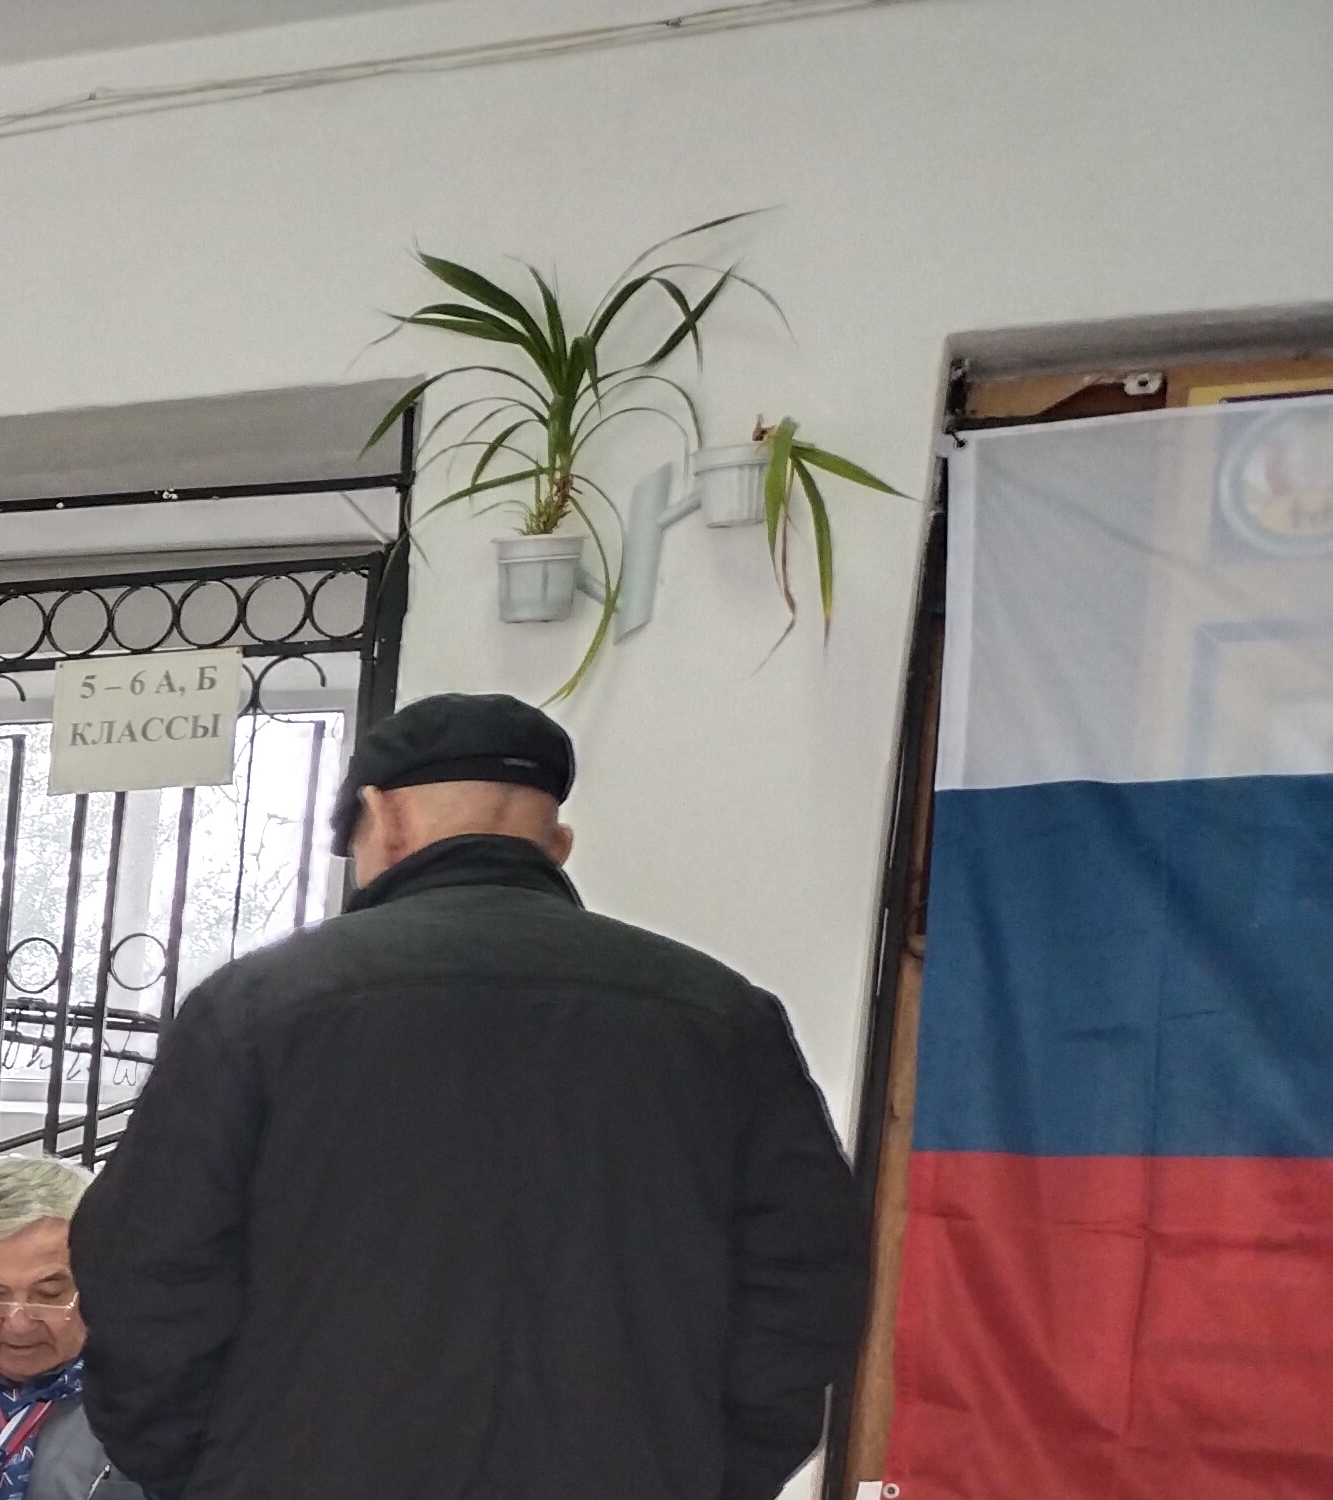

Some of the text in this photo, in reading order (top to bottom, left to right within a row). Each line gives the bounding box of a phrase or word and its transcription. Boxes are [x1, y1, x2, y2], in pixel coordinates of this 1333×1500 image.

[80, 674, 97, 699] 5
[129, 669, 147, 696] 6
[195, 665, 218, 691] Б
[69, 713, 222, 746] КЛАССЫ
